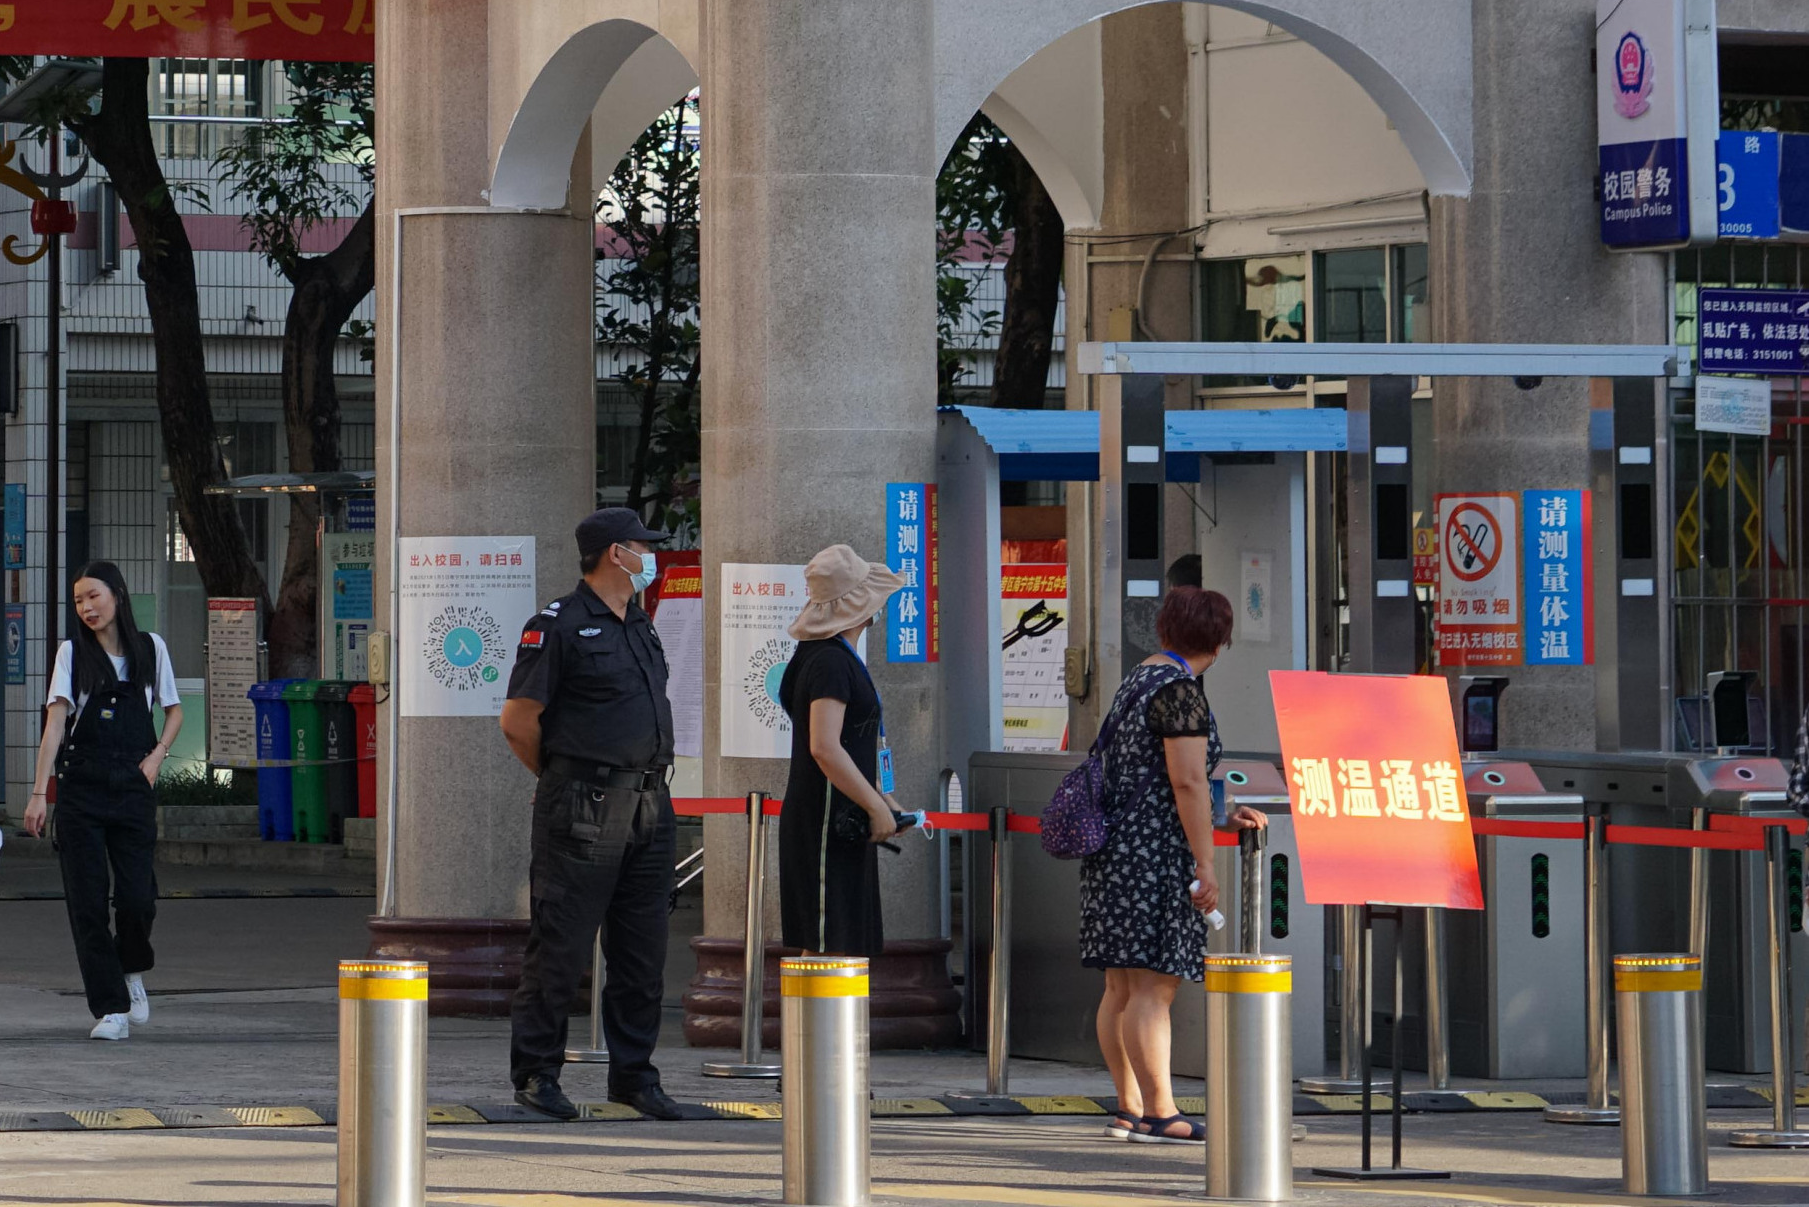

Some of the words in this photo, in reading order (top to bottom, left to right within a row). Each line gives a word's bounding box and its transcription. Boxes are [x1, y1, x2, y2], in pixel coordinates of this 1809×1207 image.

[1744, 135, 1760, 153] 路
[1603, 166, 1672, 202] 校园警务
[1604, 203, 1641, 222] Campus
[1643, 202, 1672, 218] Police
[409, 553, 522, 567] 出入校园，请扫码
[897, 489, 920, 657] 请测量体温
[1537, 496, 1571, 659] 请测量体温
[732, 582, 810, 597] 出入校园，
[1443, 598, 1510, 615] 请勿吸烟
[1291, 756, 1465, 822] 测温通道
